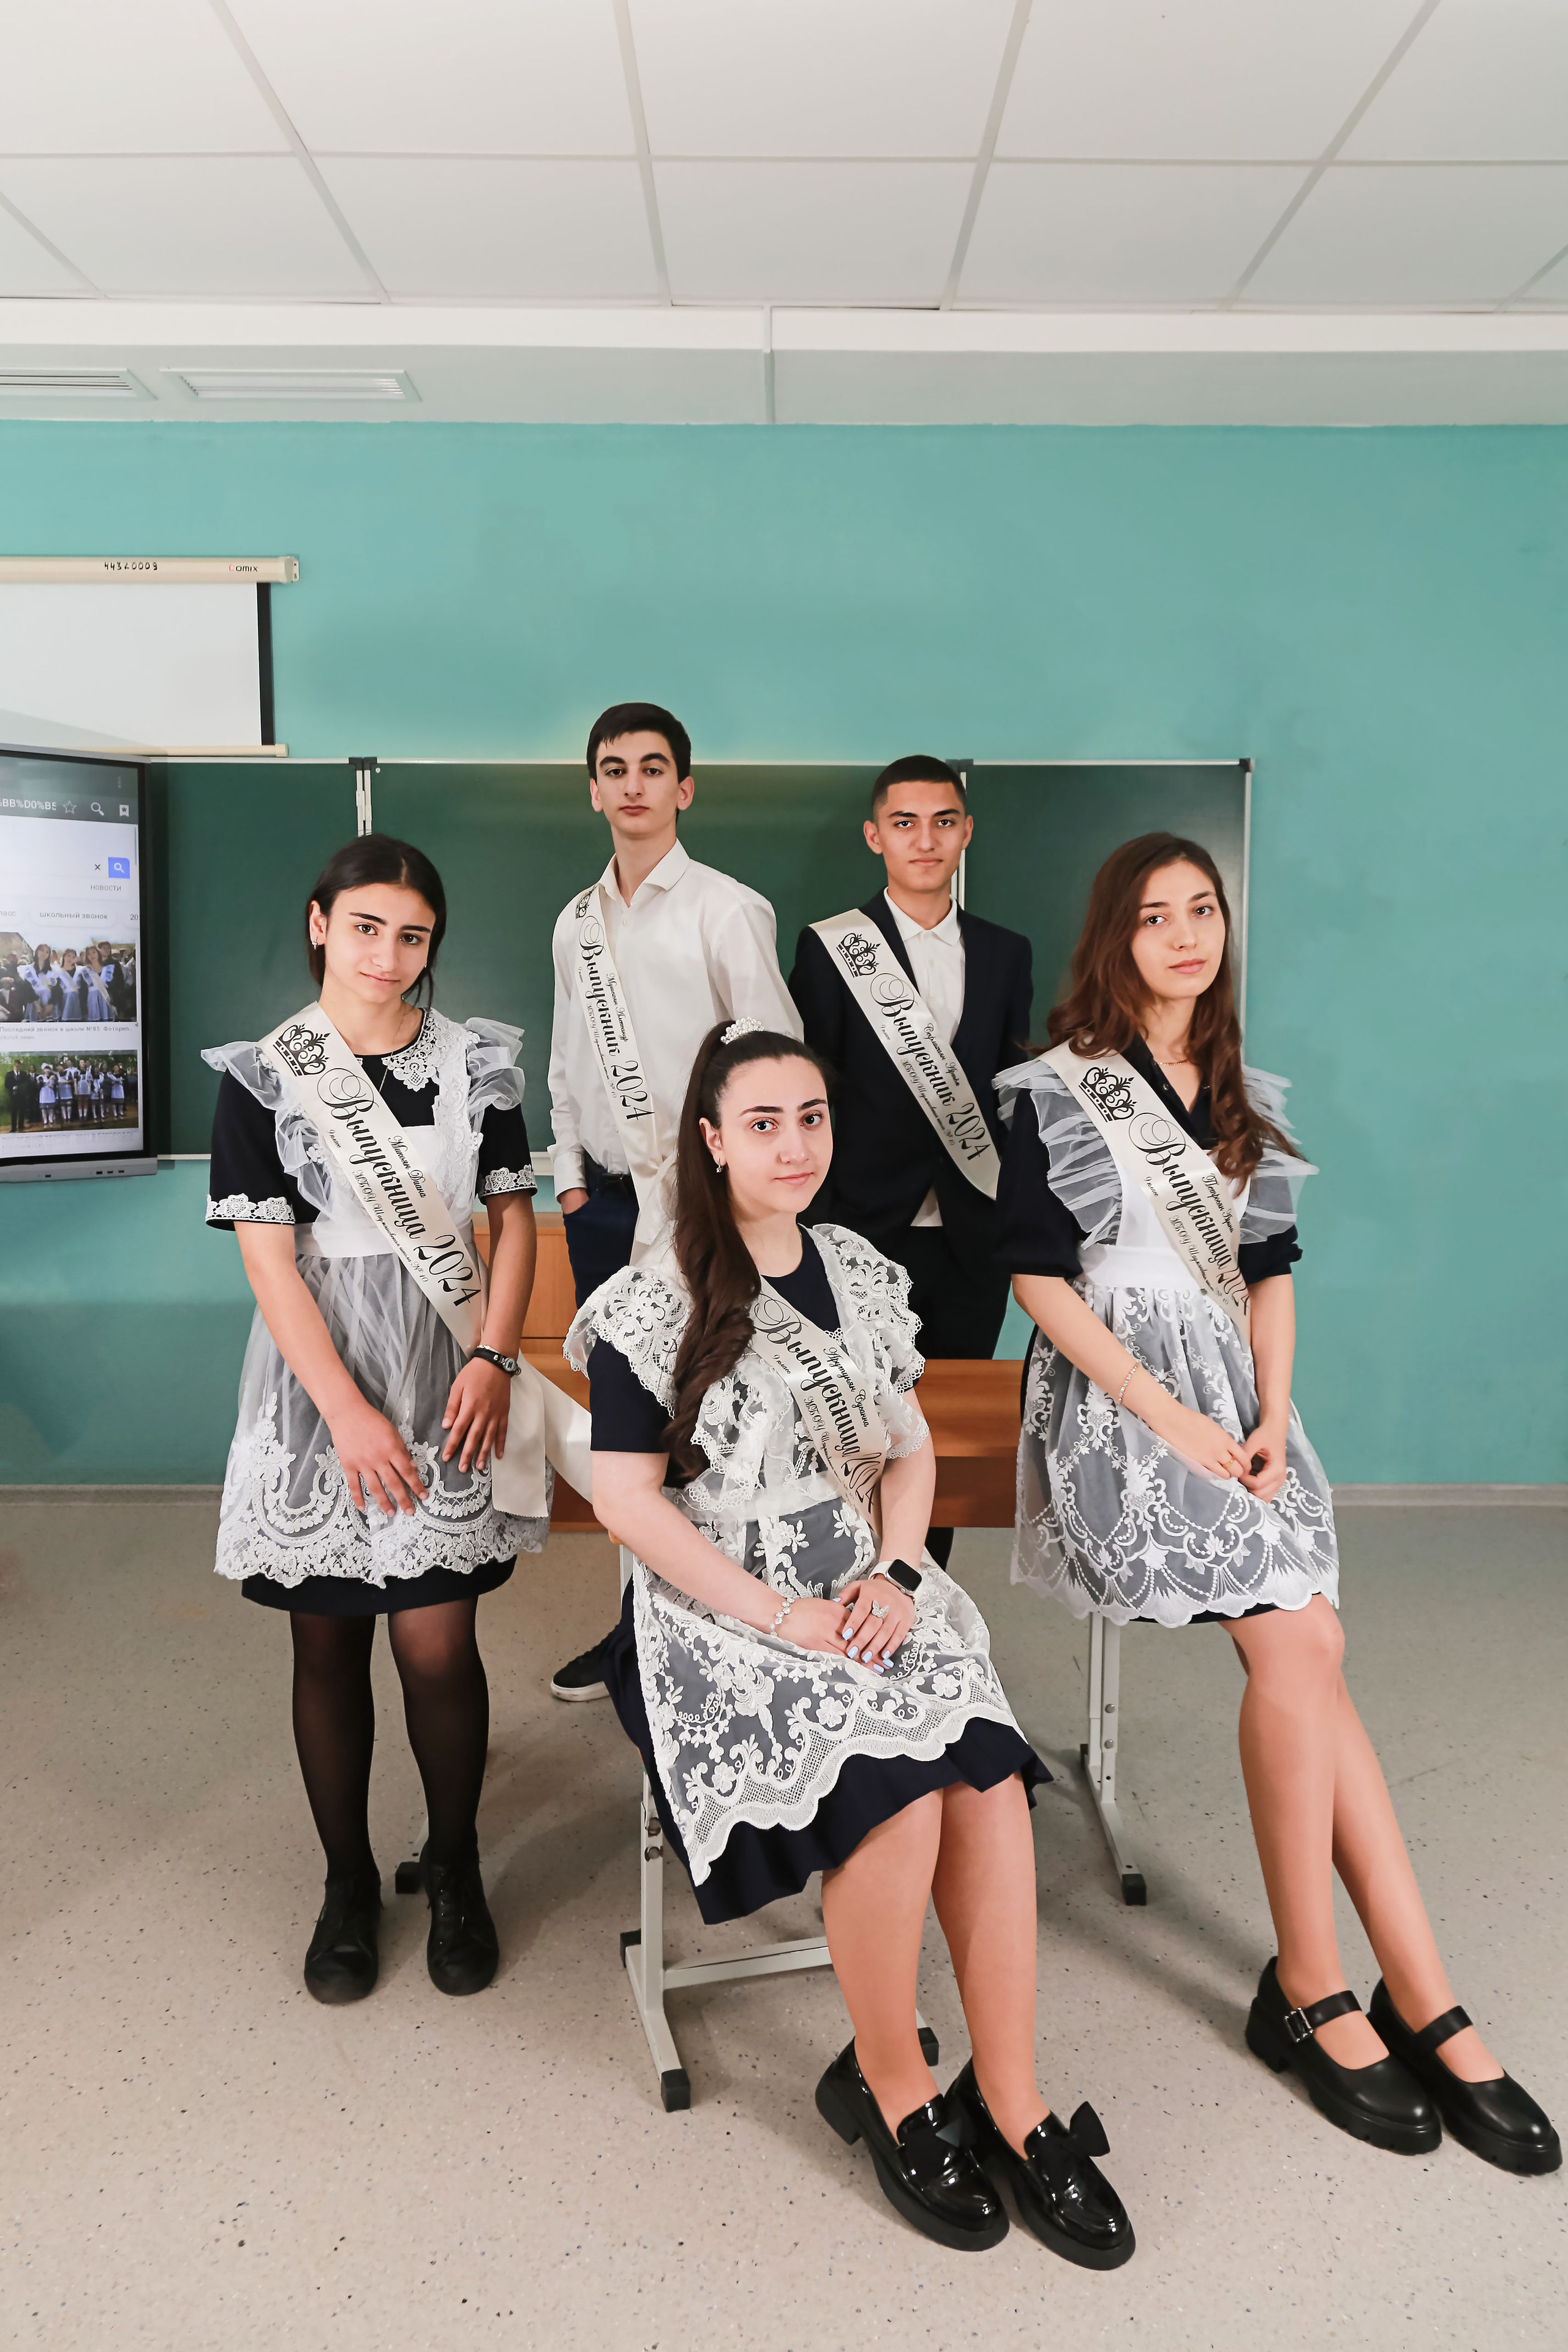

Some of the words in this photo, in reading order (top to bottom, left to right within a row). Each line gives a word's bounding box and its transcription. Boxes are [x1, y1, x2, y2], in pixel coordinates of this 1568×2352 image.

[0, 798, 56, 811] BB%D0%B5
[579, 915, 621, 1056] Выпускник
[611, 1060, 655, 1120] 2024
[870, 973, 956, 1106] Выпускник
[946, 1102, 991, 1160] 2024
[317, 1068, 426, 1240] Выпускница
[413, 1234, 481, 1306] 2024
[352, 1169, 376, 1202] МБОУ
[422, 1273, 429, 1283] 10
[388, 1135, 411, 1170] Микоян
[408, 1169, 426, 1198] Диана
[1129, 1112, 1232, 1270] Выпускница
[753, 1293, 860, 1457] Выпускница
[804, 1396, 825, 1431] МБОУ
[851, 1389, 869, 1427] Сусанна
